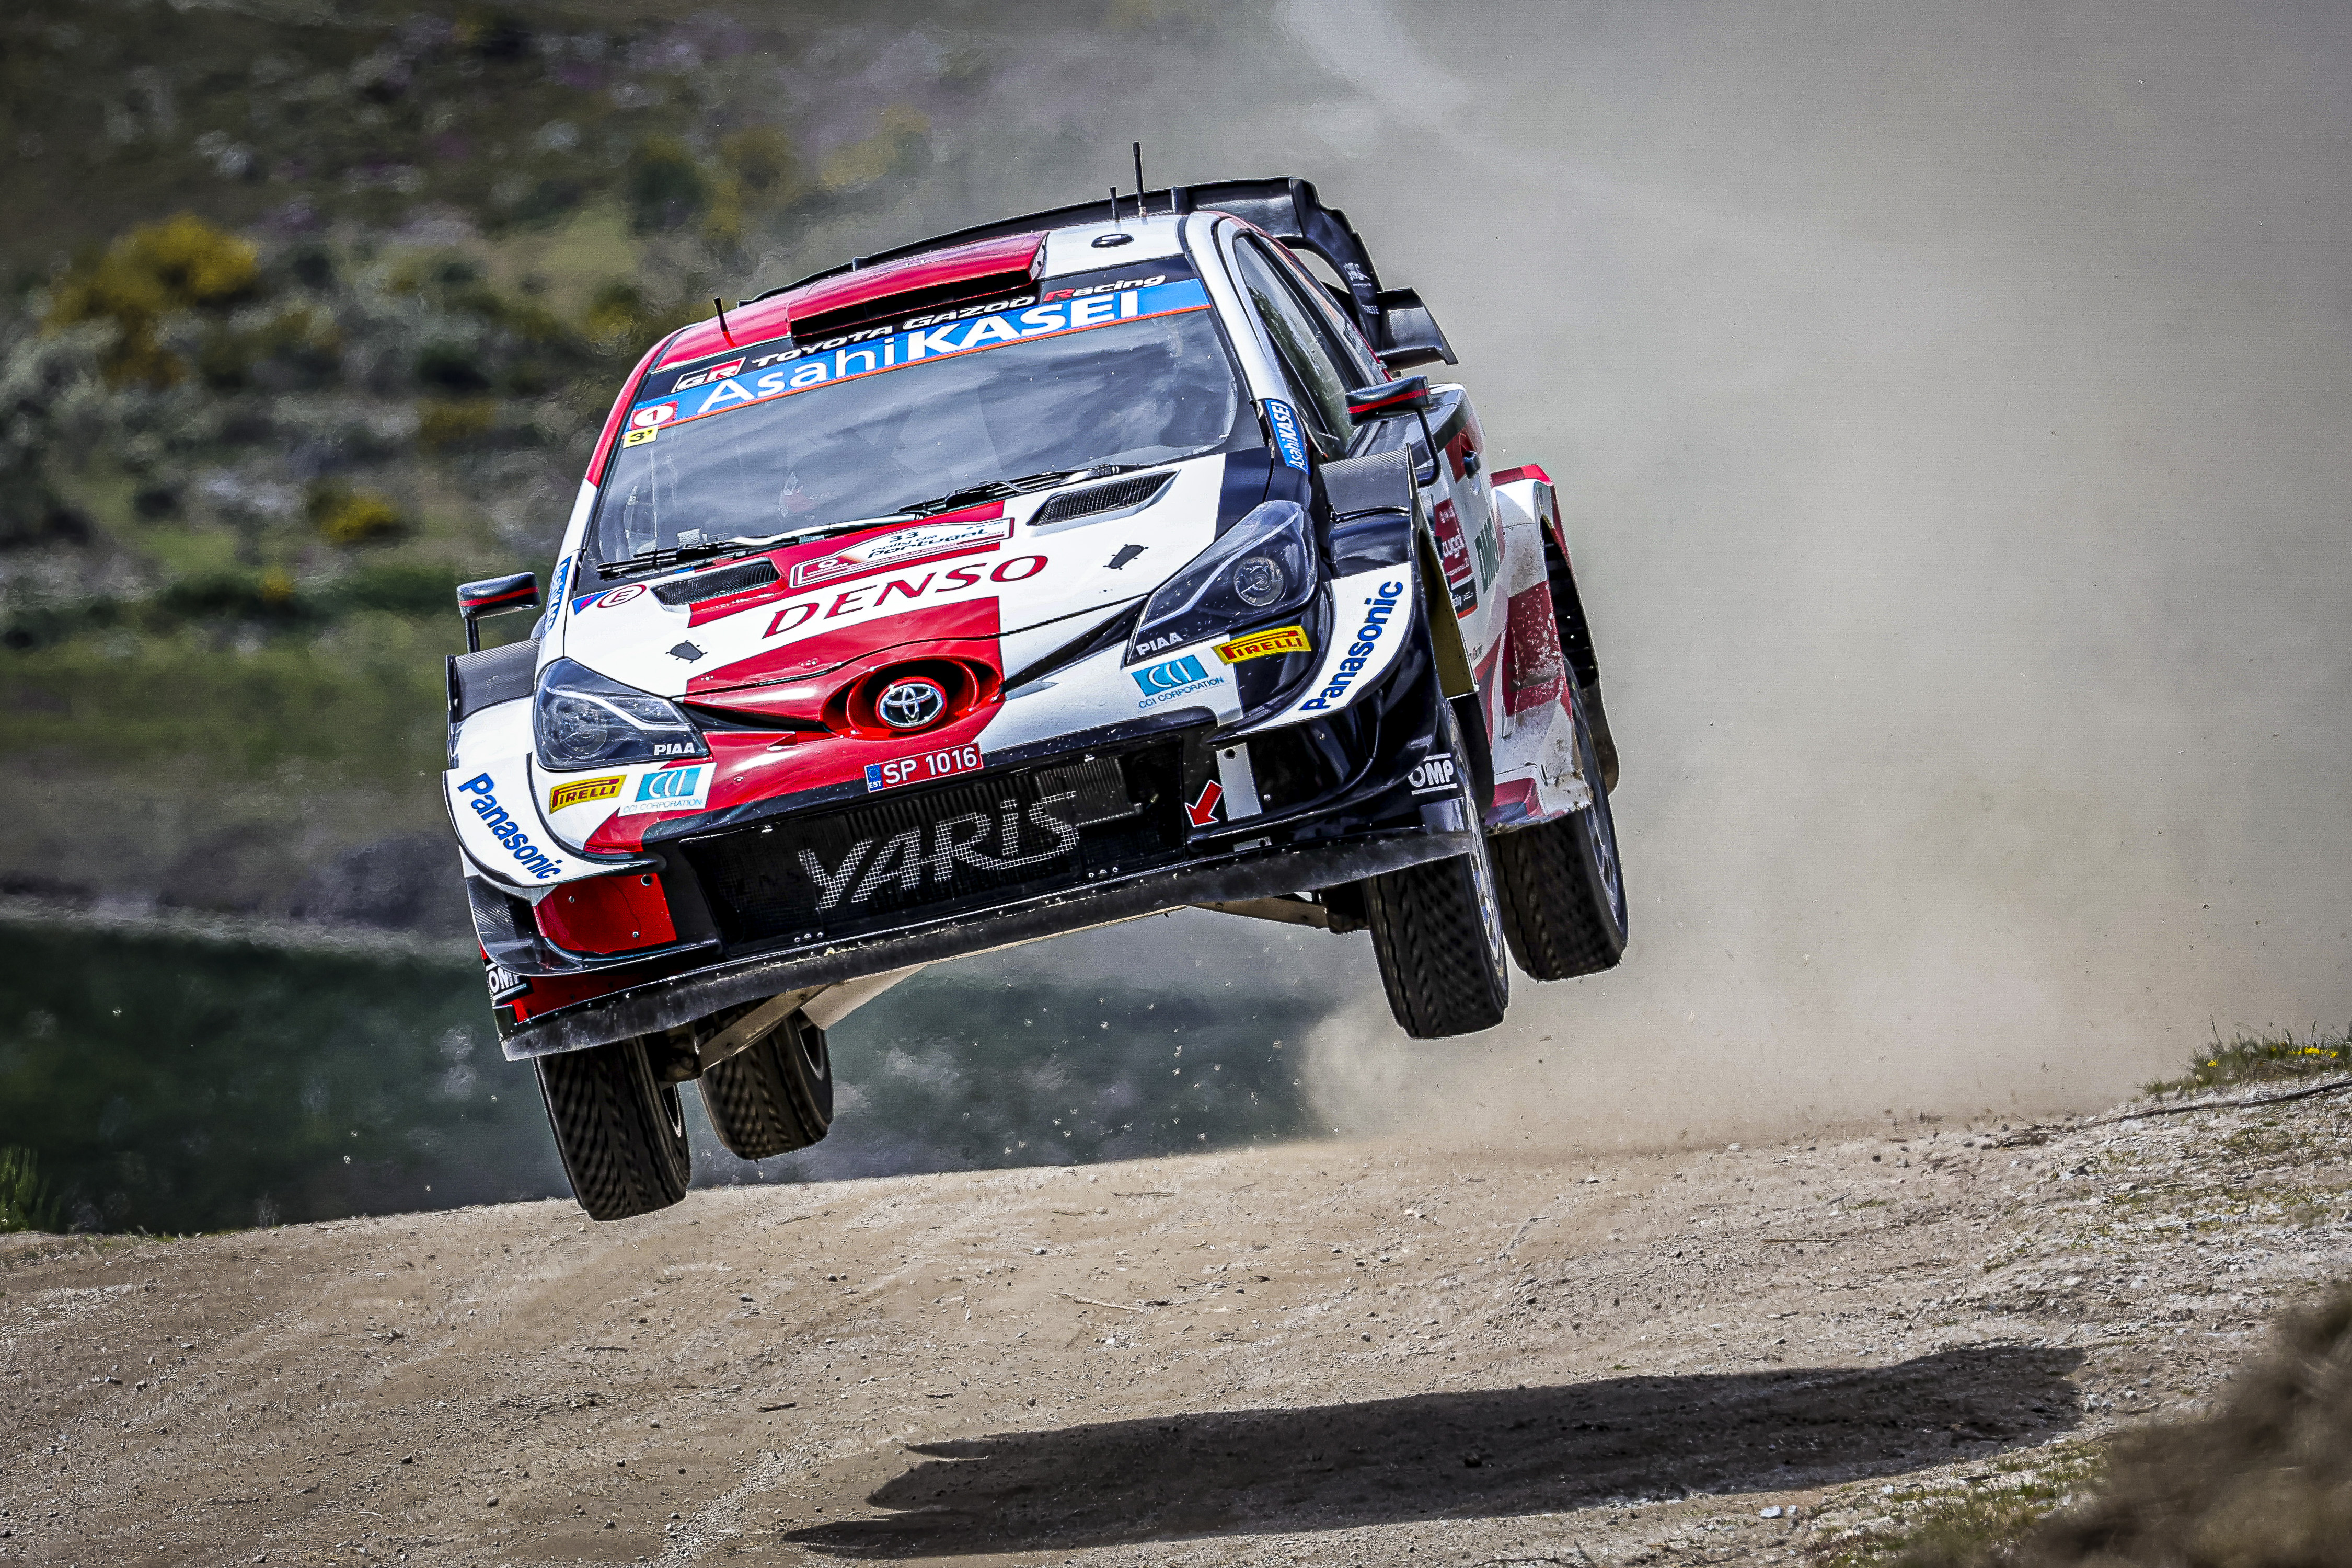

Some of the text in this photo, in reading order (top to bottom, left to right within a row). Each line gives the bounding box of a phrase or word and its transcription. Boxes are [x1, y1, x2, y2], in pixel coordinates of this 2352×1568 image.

[677, 275, 1167, 390] GR TOYOTA GAZOO Racing
[647, 409, 659, 421] 1
[889, 531, 919, 543] 33
[762, 555, 1048, 639] DENSO
[1136, 632, 1184, 656] PIAA
[1222, 629, 1304, 661] PIRELLI
[1298, 581, 1404, 712] Panasonic
[1149, 659, 1193, 689] CCI
[1138, 676, 1225, 709] CCI CORPORATION
[653, 742, 696, 756] PIAA
[868, 747, 977, 789] EST SP 1016
[1408, 759, 1454, 787] OMP
[551, 778, 620, 806] PIRELLI
[622, 798, 702, 813] CCI CORPORATION
[457, 772, 563, 879] Panasonic
